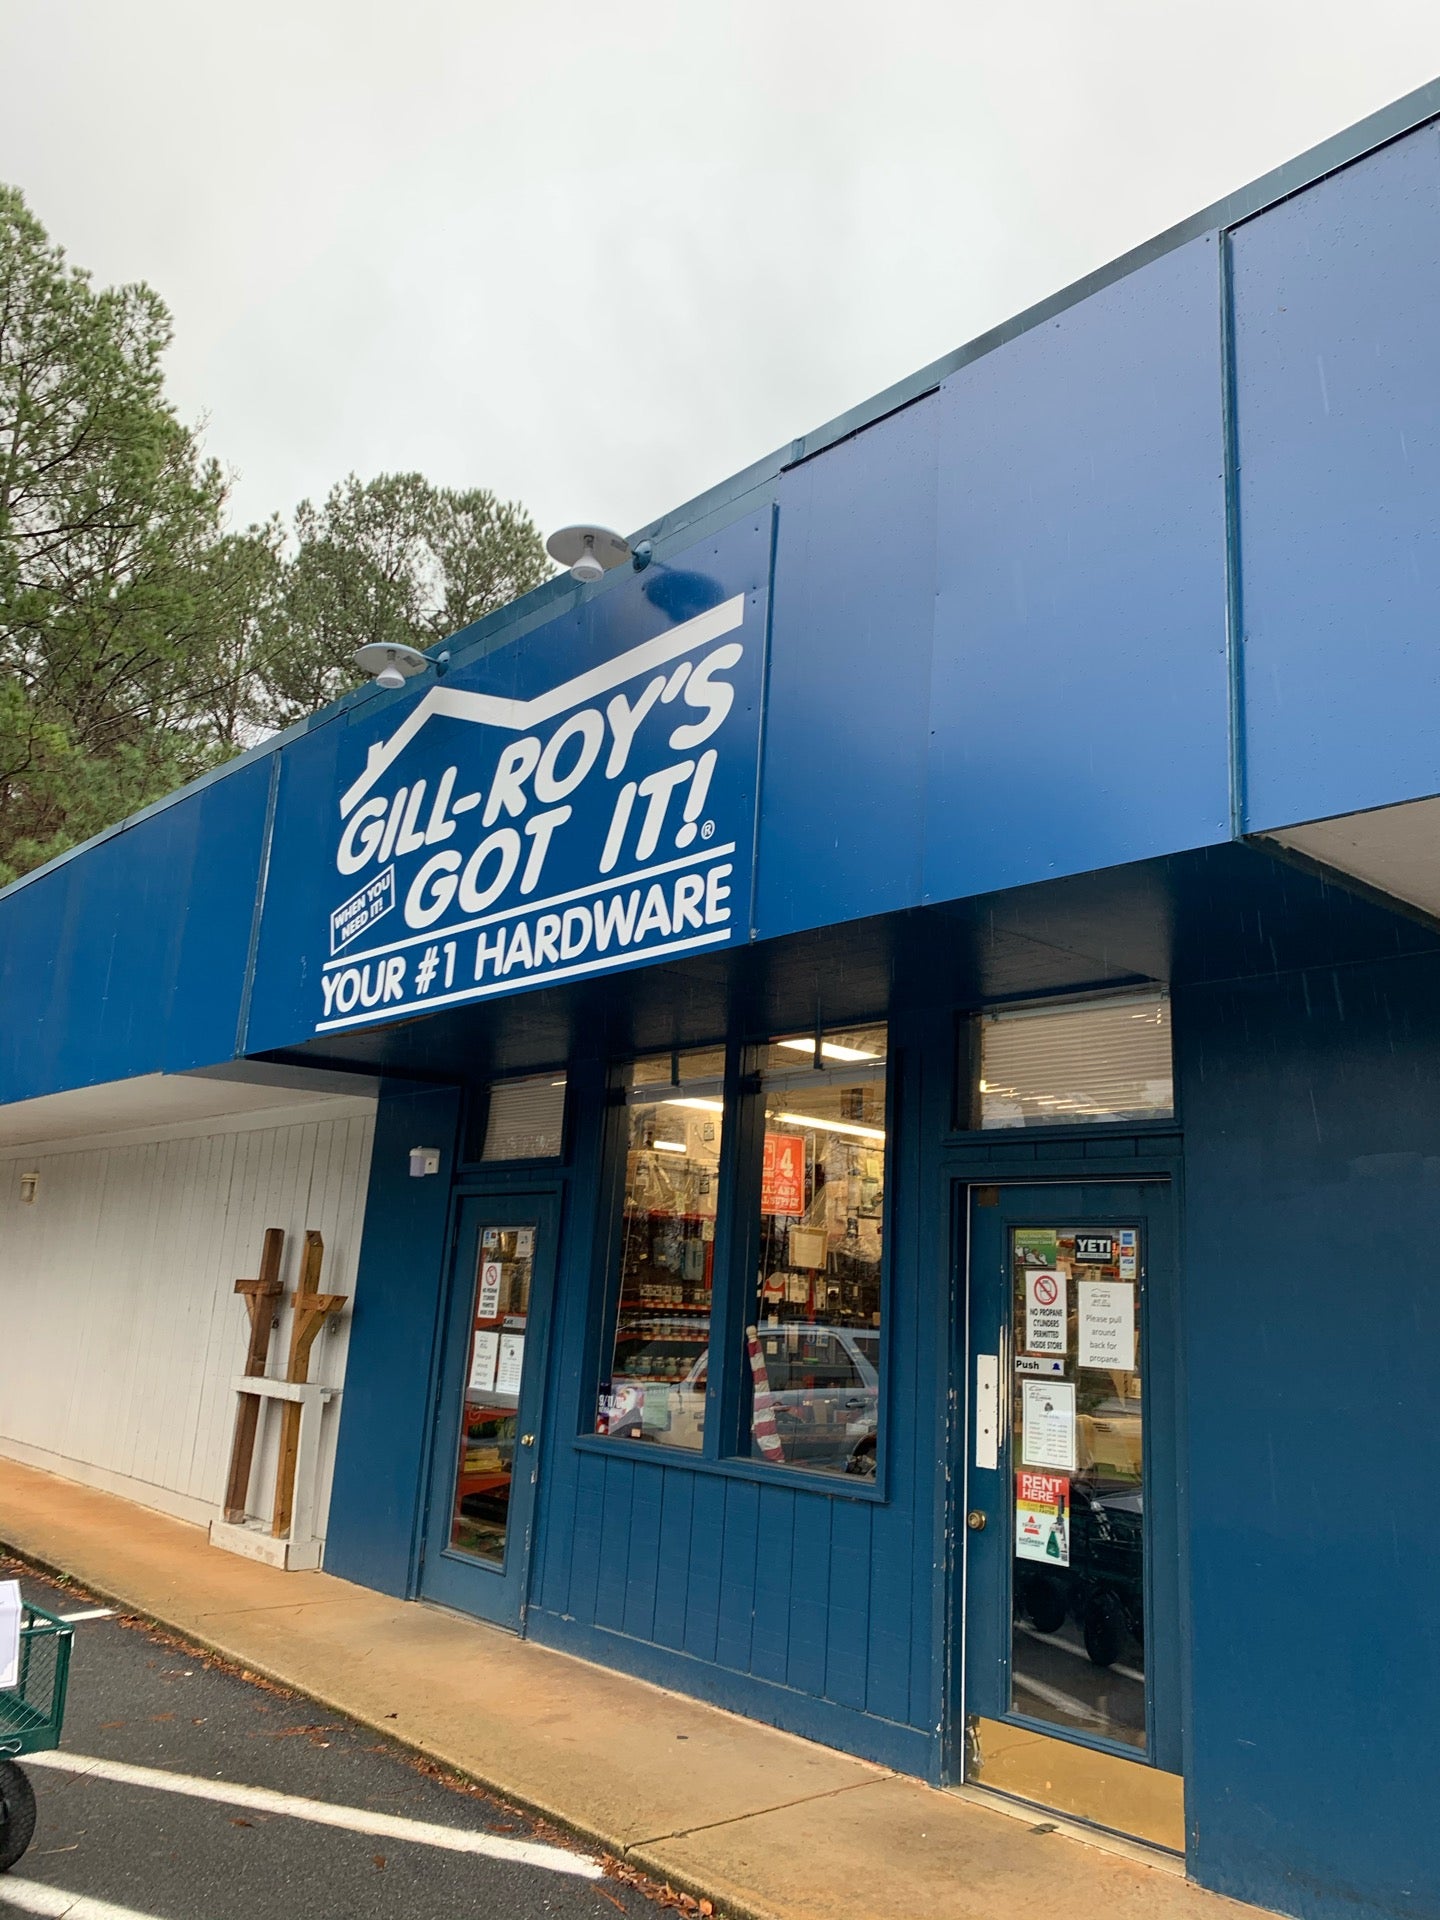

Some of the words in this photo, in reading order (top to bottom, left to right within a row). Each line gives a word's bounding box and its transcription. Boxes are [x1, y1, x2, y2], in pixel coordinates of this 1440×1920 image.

[337, 643, 744, 875] GILL-ROY'S
[404, 805, 572, 929] GOT
[599, 749, 718, 874] IT!
[334, 894, 366, 930] WHEN
[366, 873, 391, 902] YOU
[341, 910, 369, 941] NEED
[369, 897, 384, 918] IT!
[321, 956, 406, 1016] YOUR
[415, 941, 457, 995] #1
[474, 863, 733, 980] HARDWARE
[1076, 1239, 1111, 1252] YETI
[1030, 1308, 1038, 1316] NO
[1039, 1308, 1063, 1317] PROPANE
[1033, 1319, 1060, 1328] CYLINDERS
[1086, 1314, 1108, 1323] Please
[1109, 1315, 1122, 1324] pull
[1033, 1330, 1059, 1339] PERMITTED
[1091, 1329, 1117, 1337] around
[1030, 1341, 1046, 1350] INSIDE
[1046, 1341, 1063, 1350] STORE
[1089, 1341, 1106, 1349] back
[1106, 1341, 1118, 1350] for
[1016, 1360, 1040, 1370] Push
[1022, 1474, 1062, 1492] RENT
[1022, 1487, 1054, 1503] HERE
